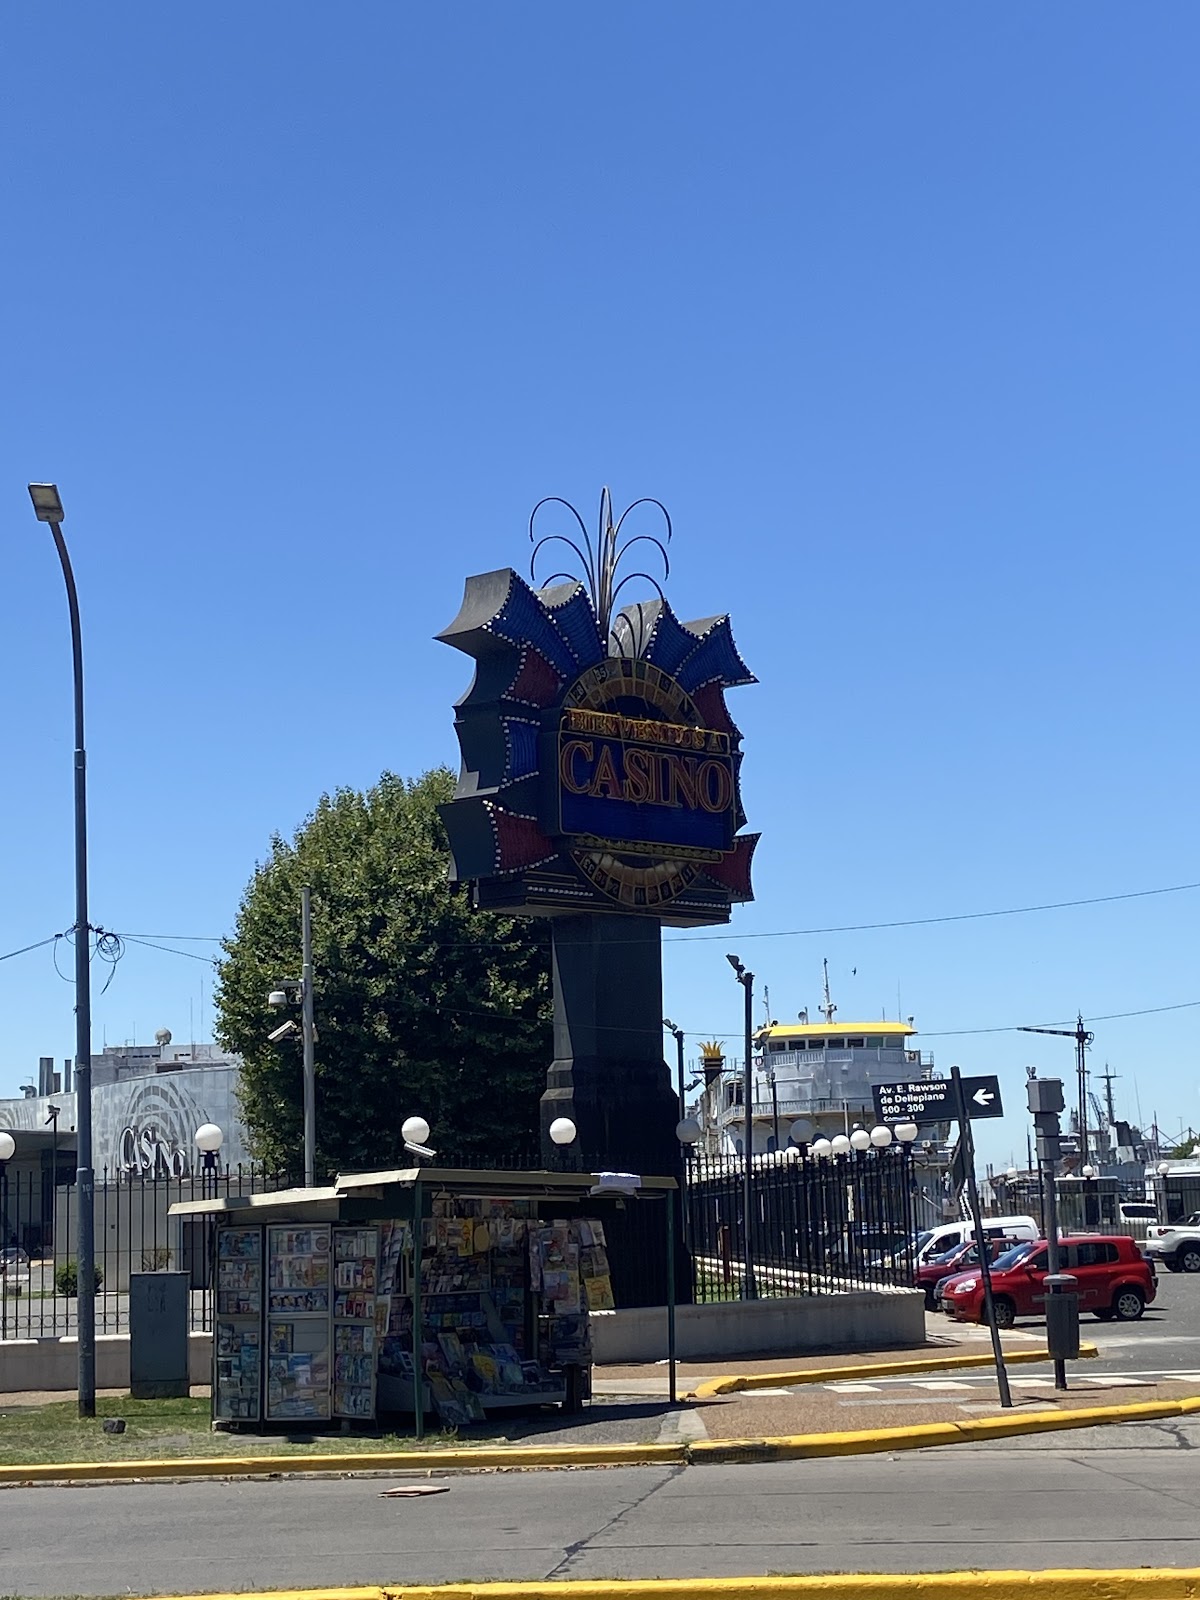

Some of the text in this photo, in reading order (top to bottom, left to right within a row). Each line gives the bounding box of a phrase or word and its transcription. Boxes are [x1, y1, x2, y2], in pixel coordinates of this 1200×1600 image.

[706, 732, 724, 752] A
[560, 740, 733, 813] CASINO
[879, 1083, 947, 1095] Av. E. Rawson
[881, 1093, 945, 1104] de Dellepiane
[882, 1105, 900, 1114] 500
[907, 1104, 924, 1112] 300
